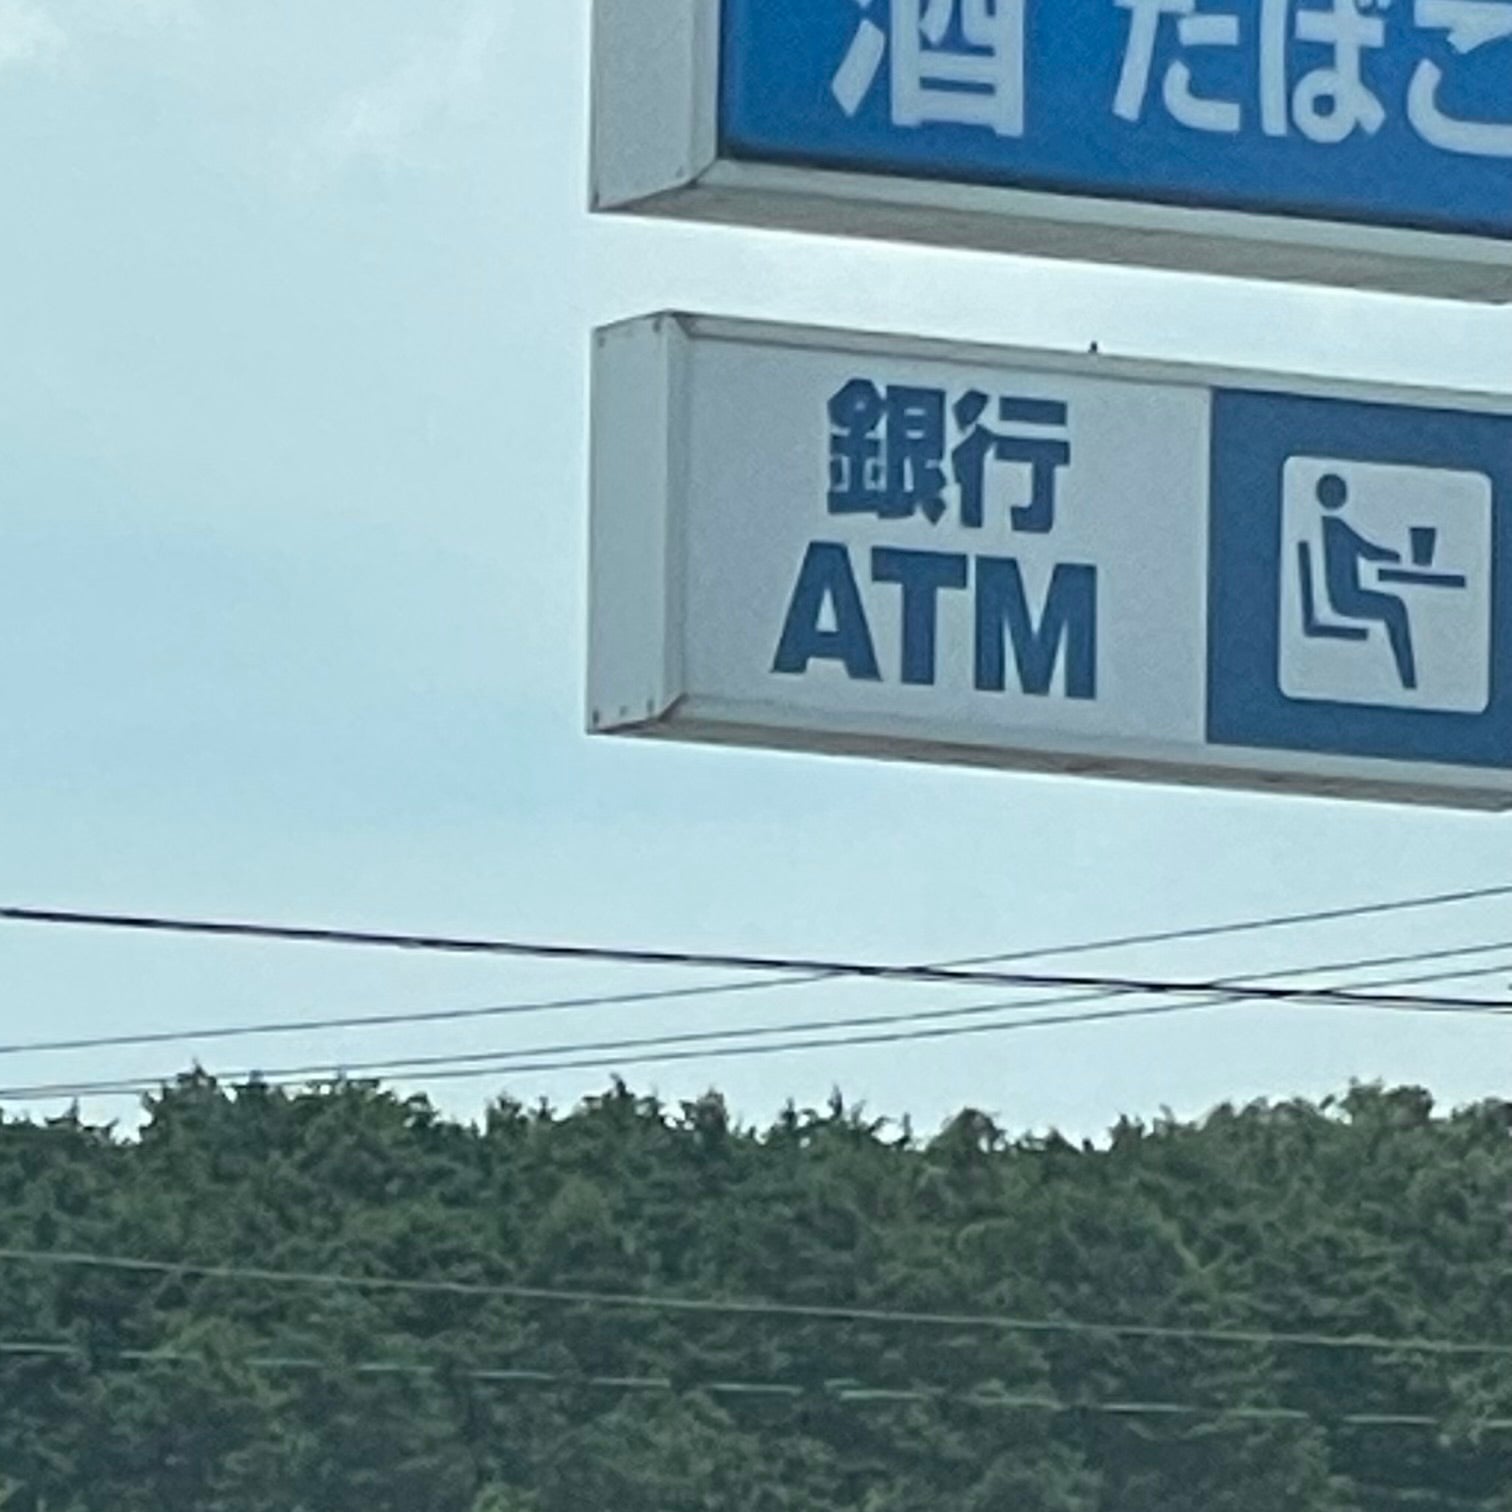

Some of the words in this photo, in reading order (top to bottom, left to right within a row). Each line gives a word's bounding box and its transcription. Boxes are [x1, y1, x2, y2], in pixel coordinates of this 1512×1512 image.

[830, 0, 1025, 138] 酒
[1112, 0, 1512, 157] たばこ
[826, 377, 1071, 535] 銀行
[769, 539, 1098, 701] ATM
